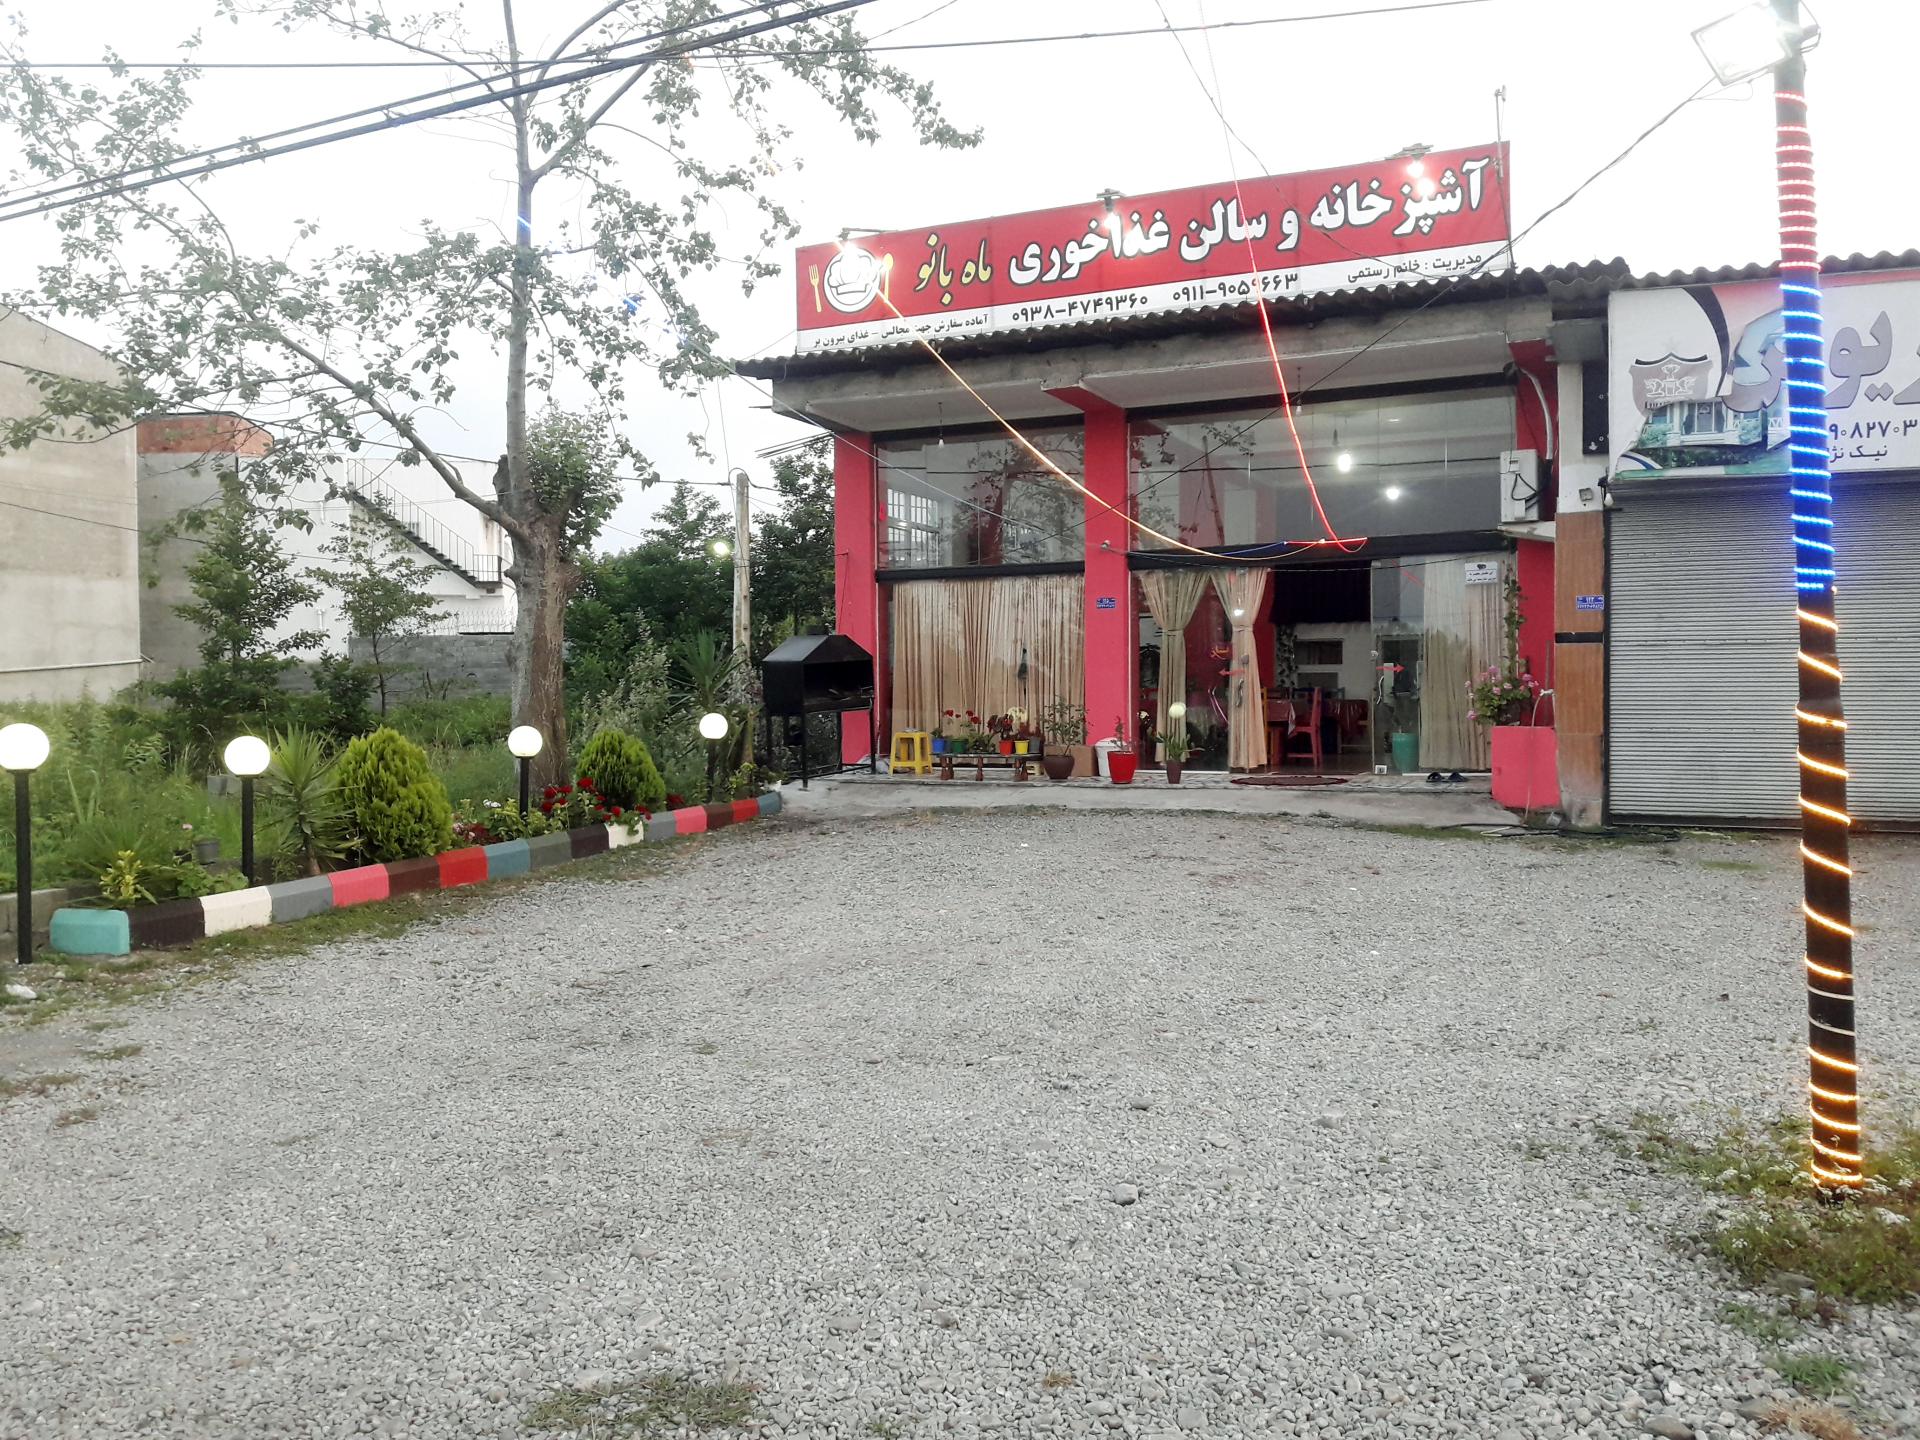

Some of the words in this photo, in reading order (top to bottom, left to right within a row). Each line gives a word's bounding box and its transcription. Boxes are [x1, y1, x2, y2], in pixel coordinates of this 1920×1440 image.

[1179, 198, 1268, 261] سالن
[1276, 209, 1300, 251] و
[1008, 208, 1172, 285] غذاخوری
[914, 232, 954, 306] بانو
[960, 240, 994, 286] ماه
[1394, 260, 1420, 277] خانم
[1433, 255, 1482, 272] مدیریت
[1348, 266, 1390, 283] رستمی
[1012, 293, 1148, 322] ۰۹۳۸-۴۷۴۹۳۶۰
[934, 317, 963, 333] سفارش
[965, 313, 988, 327] آماده
[847, 331, 869, 343] غذای
[881, 326, 909, 339] مجالس
[823, 336, 845, 347] بیرون
[1849, 445, 1888, 461] نیک
